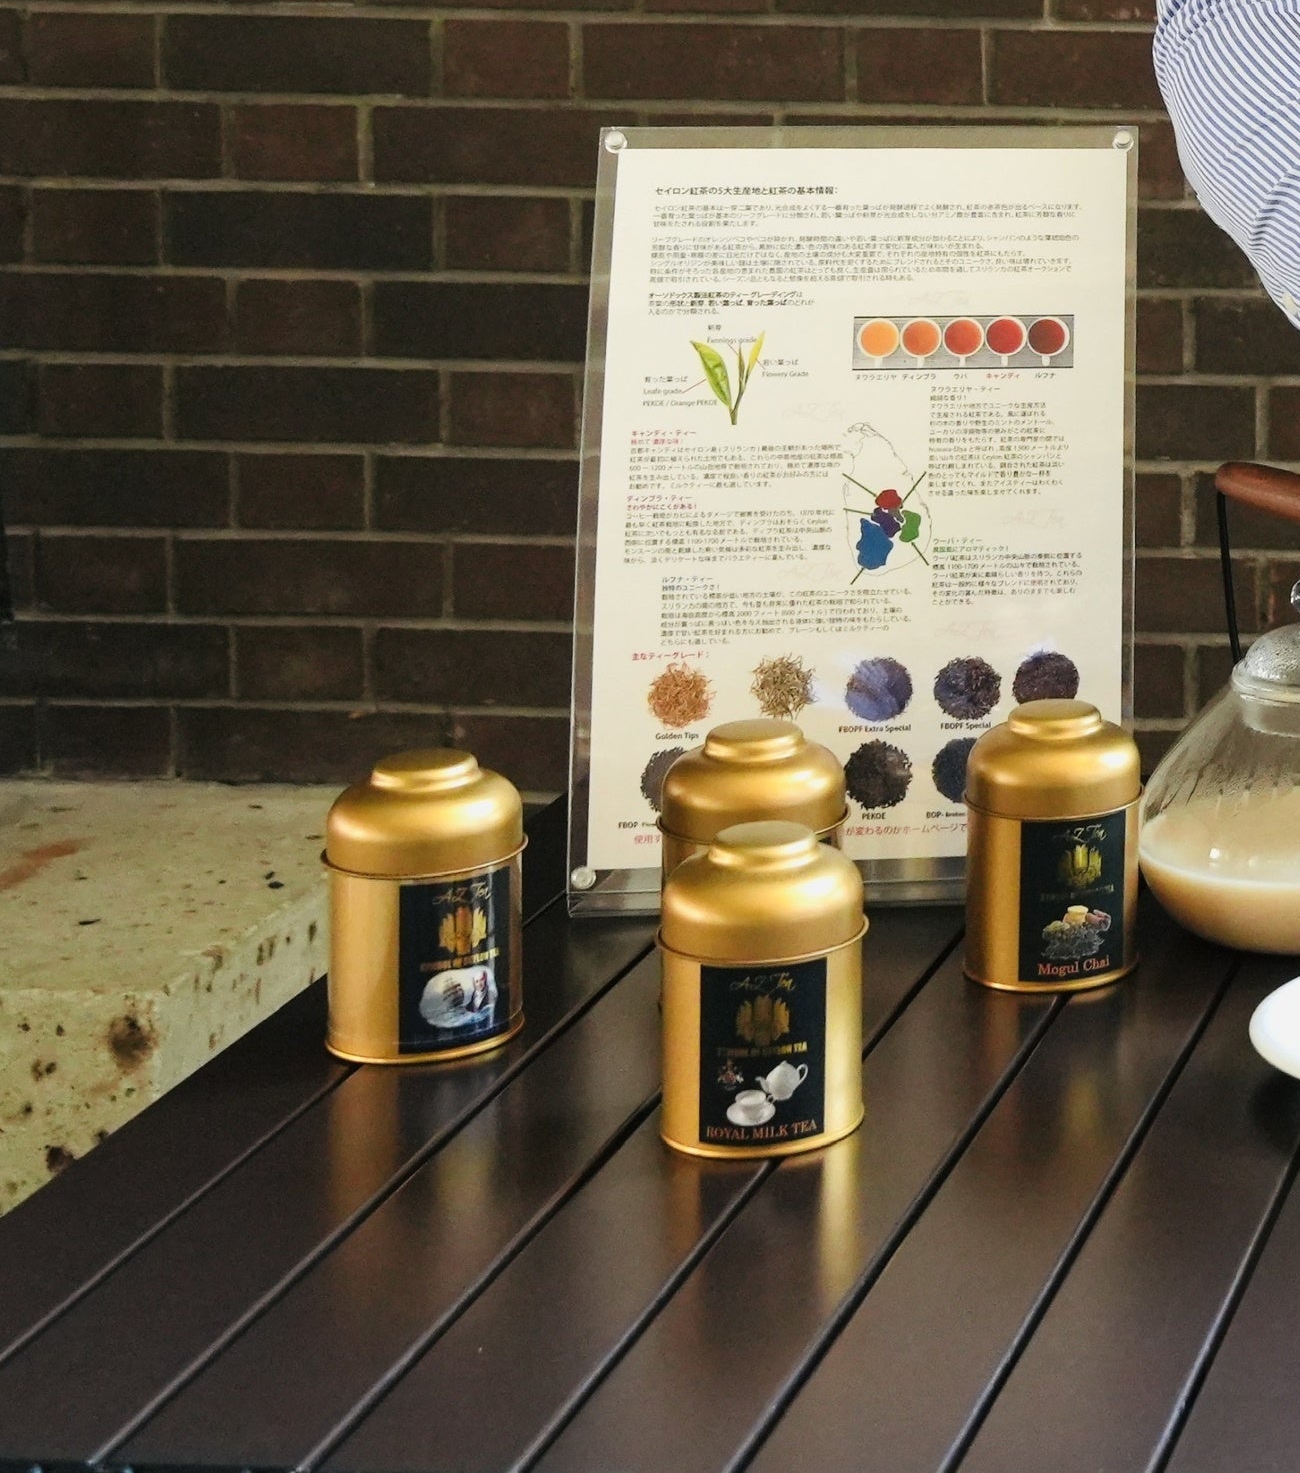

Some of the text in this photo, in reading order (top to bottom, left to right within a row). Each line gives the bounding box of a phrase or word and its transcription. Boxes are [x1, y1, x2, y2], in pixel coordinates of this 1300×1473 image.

[643, 399, 665, 407] PEKOE
[670, 399, 696, 408] Orange
[864, 725, 884, 733] Extra
[885, 724, 912, 733] Special
[965, 721, 992, 730] Special
[655, 731, 700, 741] Golden Tips
[861, 812, 886, 820] PEKOE
[618, 821, 639, 829] FBOP
[1037, 954, 1110, 978] Mogul Chai
[793, 1041, 808, 1053] TEA
[706, 1118, 818, 1140] ROYAL MILK TEA
